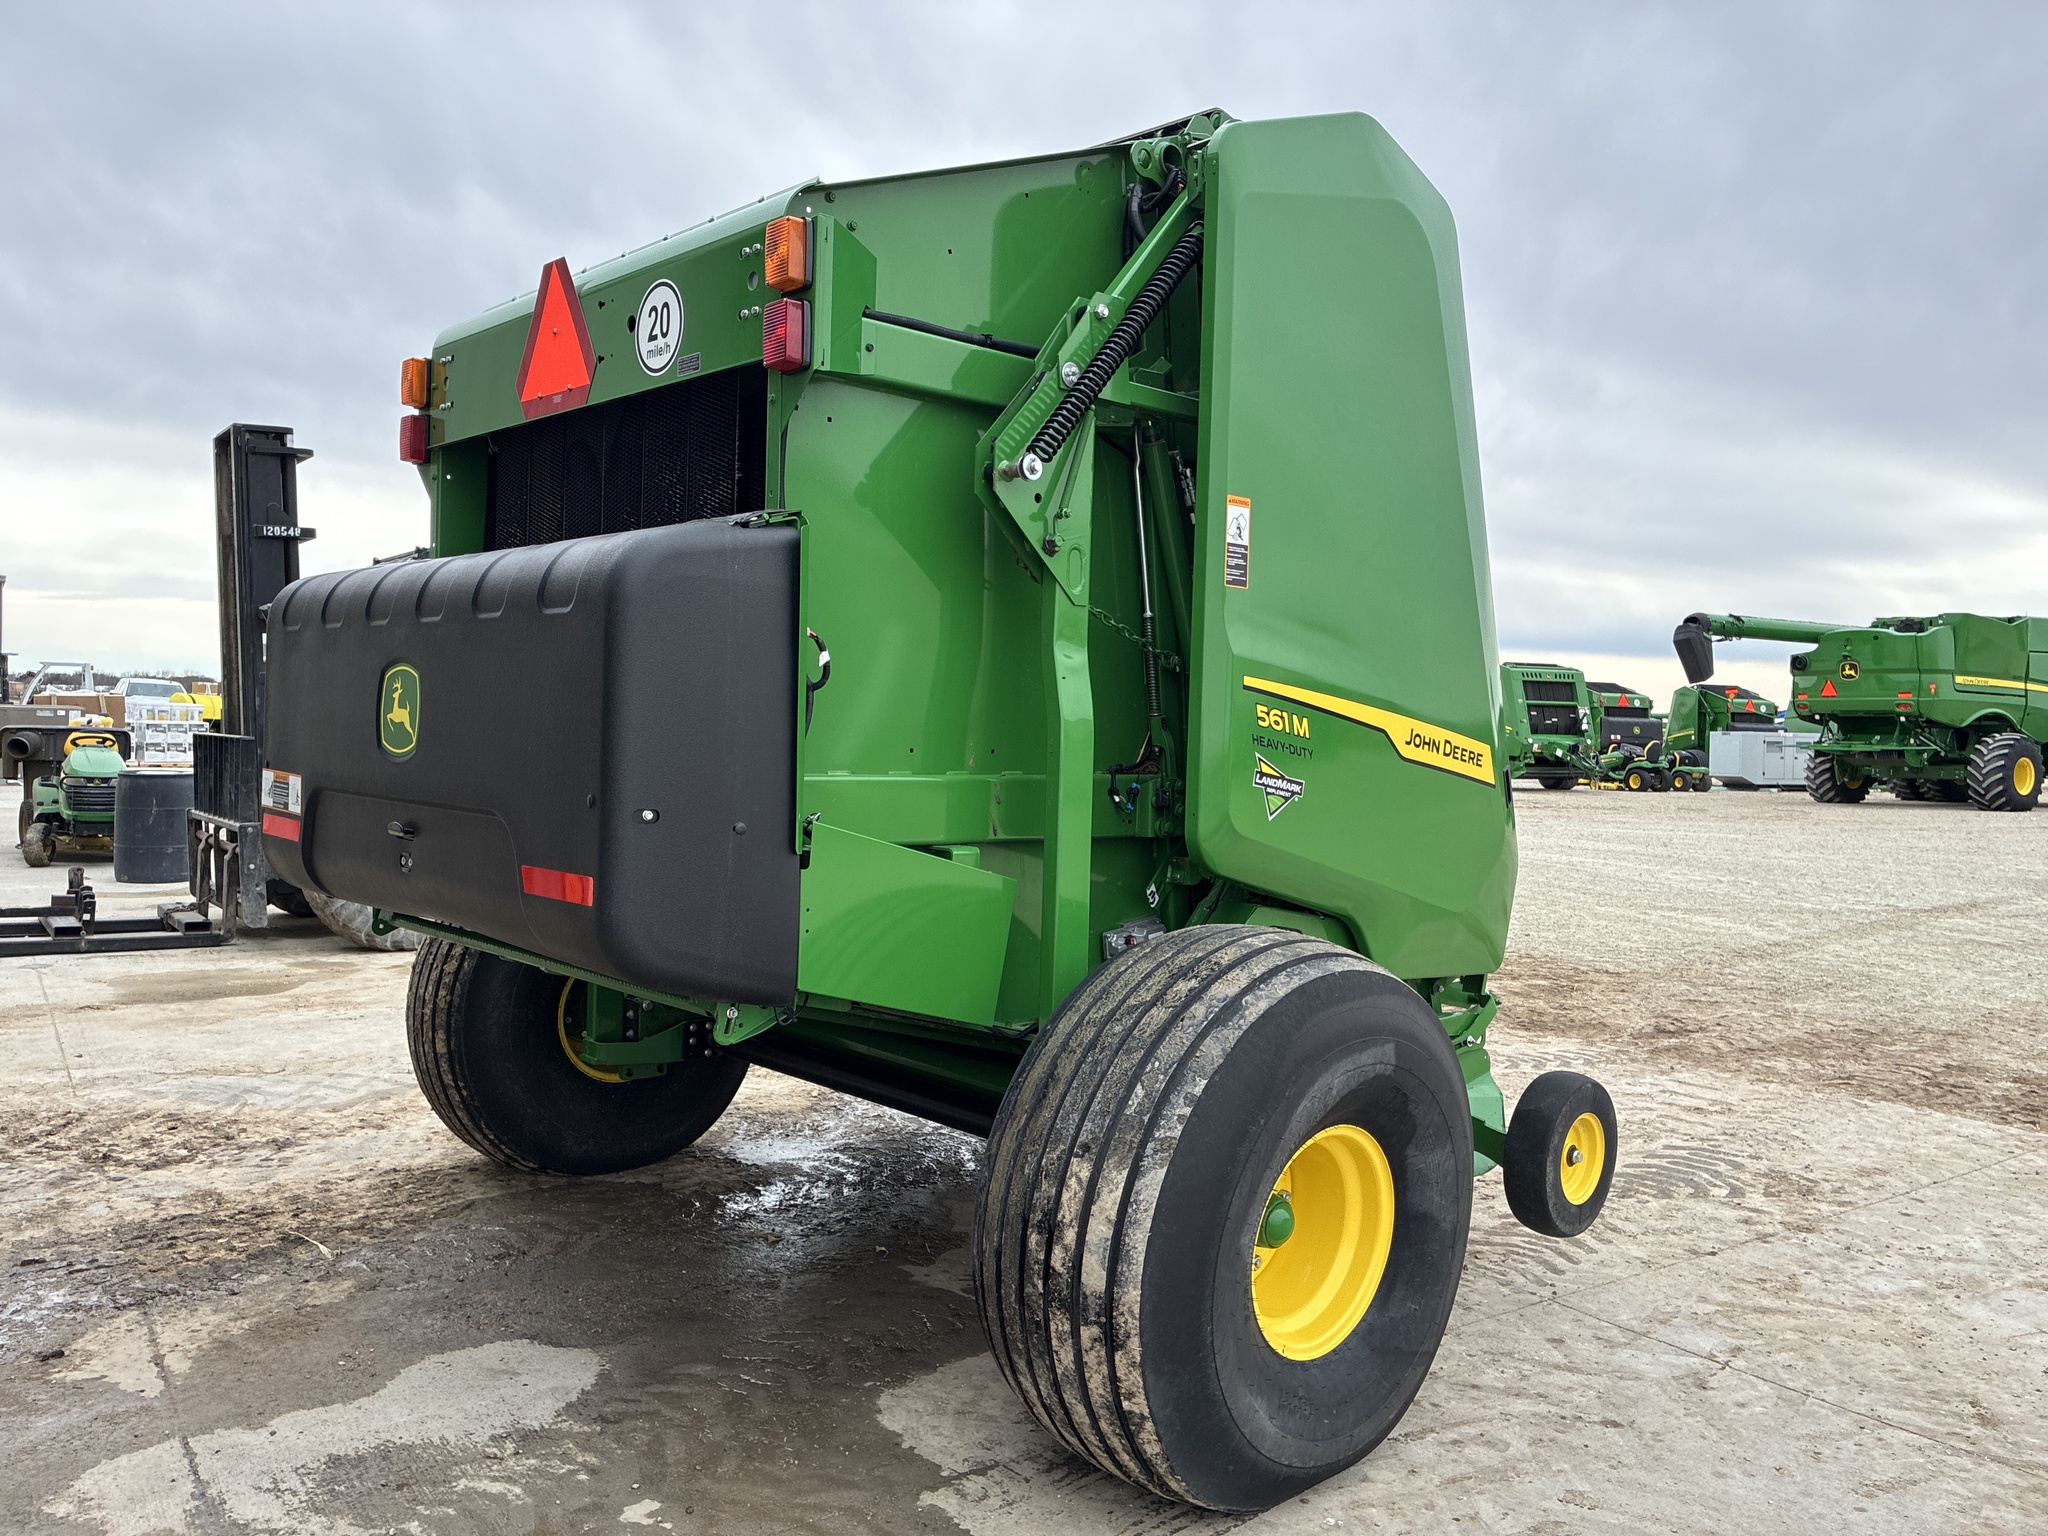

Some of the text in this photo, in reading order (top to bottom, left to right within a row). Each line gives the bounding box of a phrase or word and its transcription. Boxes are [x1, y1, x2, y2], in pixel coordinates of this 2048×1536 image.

[648, 301, 671, 343] 20
[646, 342, 671, 360] mile/h
[1231, 498, 1250, 507] WARNING
[1251, 733, 1314, 760] HEAVY-DUTY
[1405, 728, 1484, 768] JOHN DEERE
